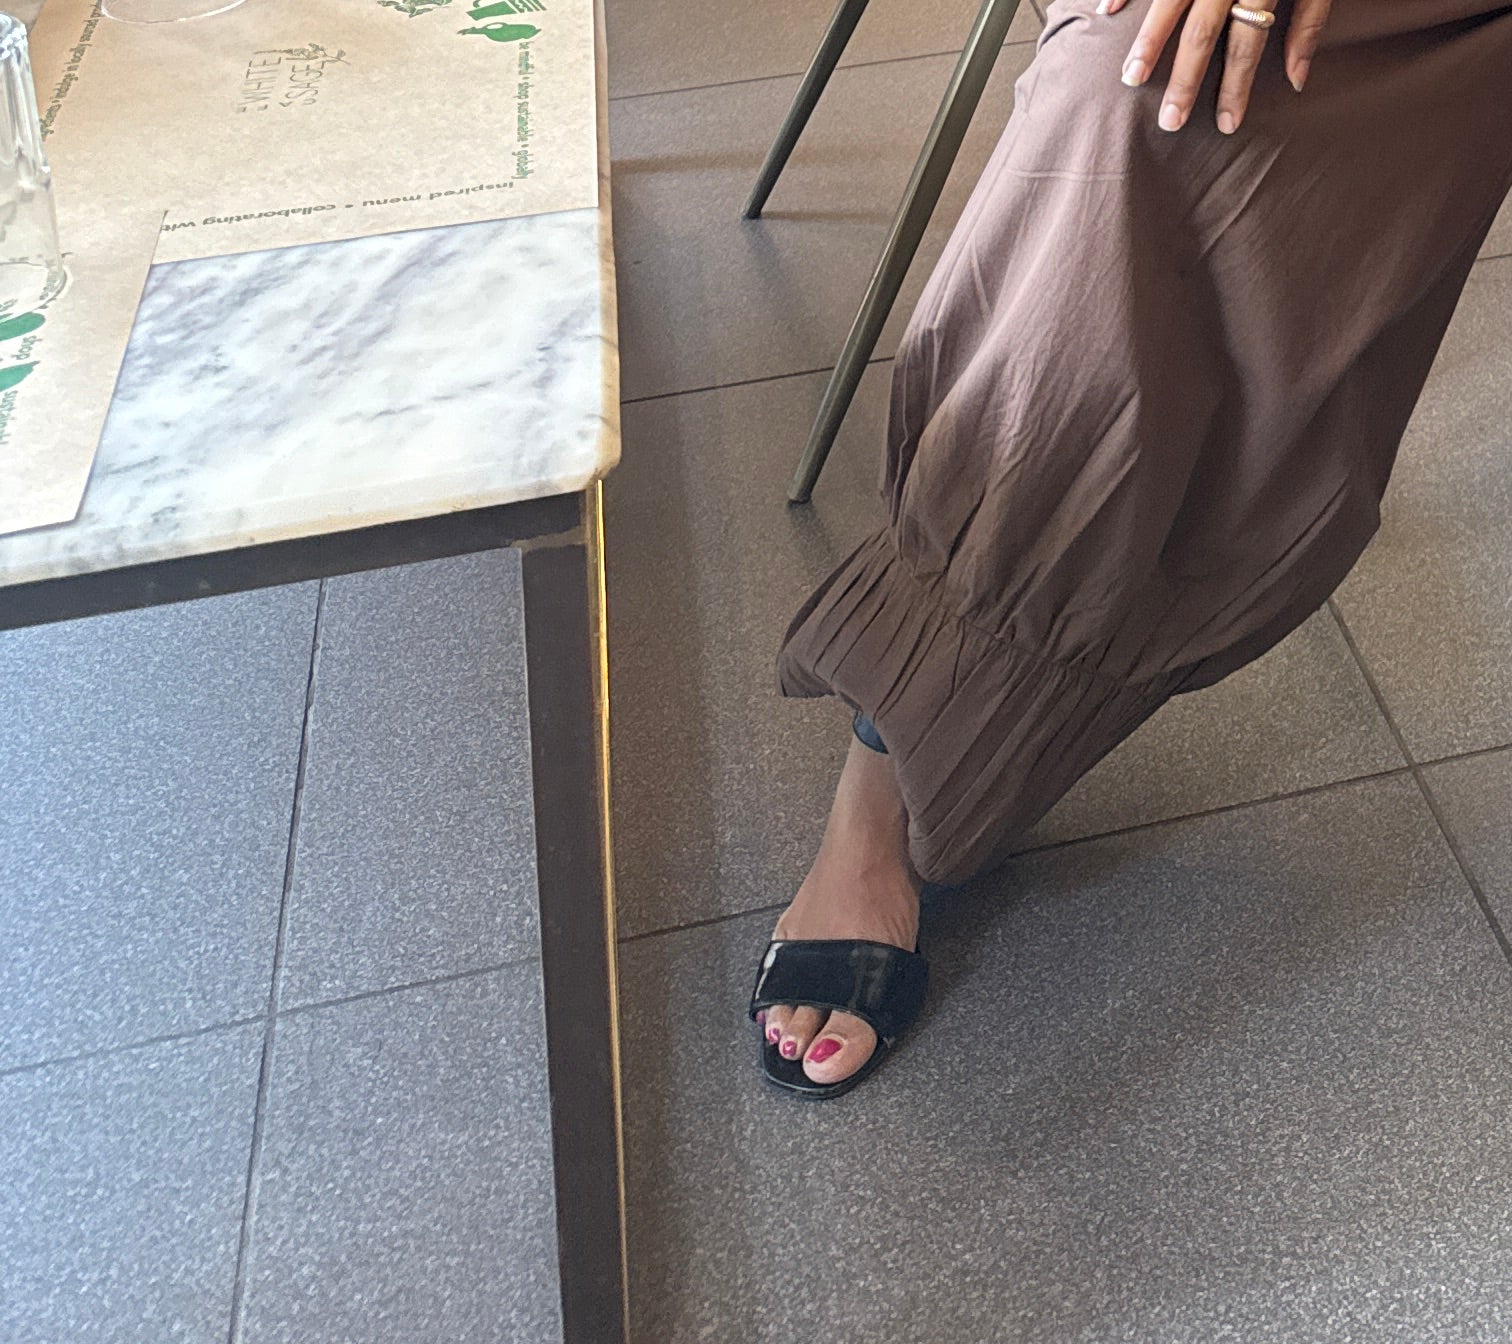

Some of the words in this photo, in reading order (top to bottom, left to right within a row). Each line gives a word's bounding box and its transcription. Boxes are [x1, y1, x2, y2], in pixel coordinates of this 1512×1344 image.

[239, 57, 282, 104] WHITE
[284, 60, 325, 99] SAGE
[362, 194, 422, 206] menu
[429, 181, 514, 200] inspired
[202, 203, 337, 225] collaborating
[160, 221, 197, 231] wit
[11, 335, 43, 361] shop
